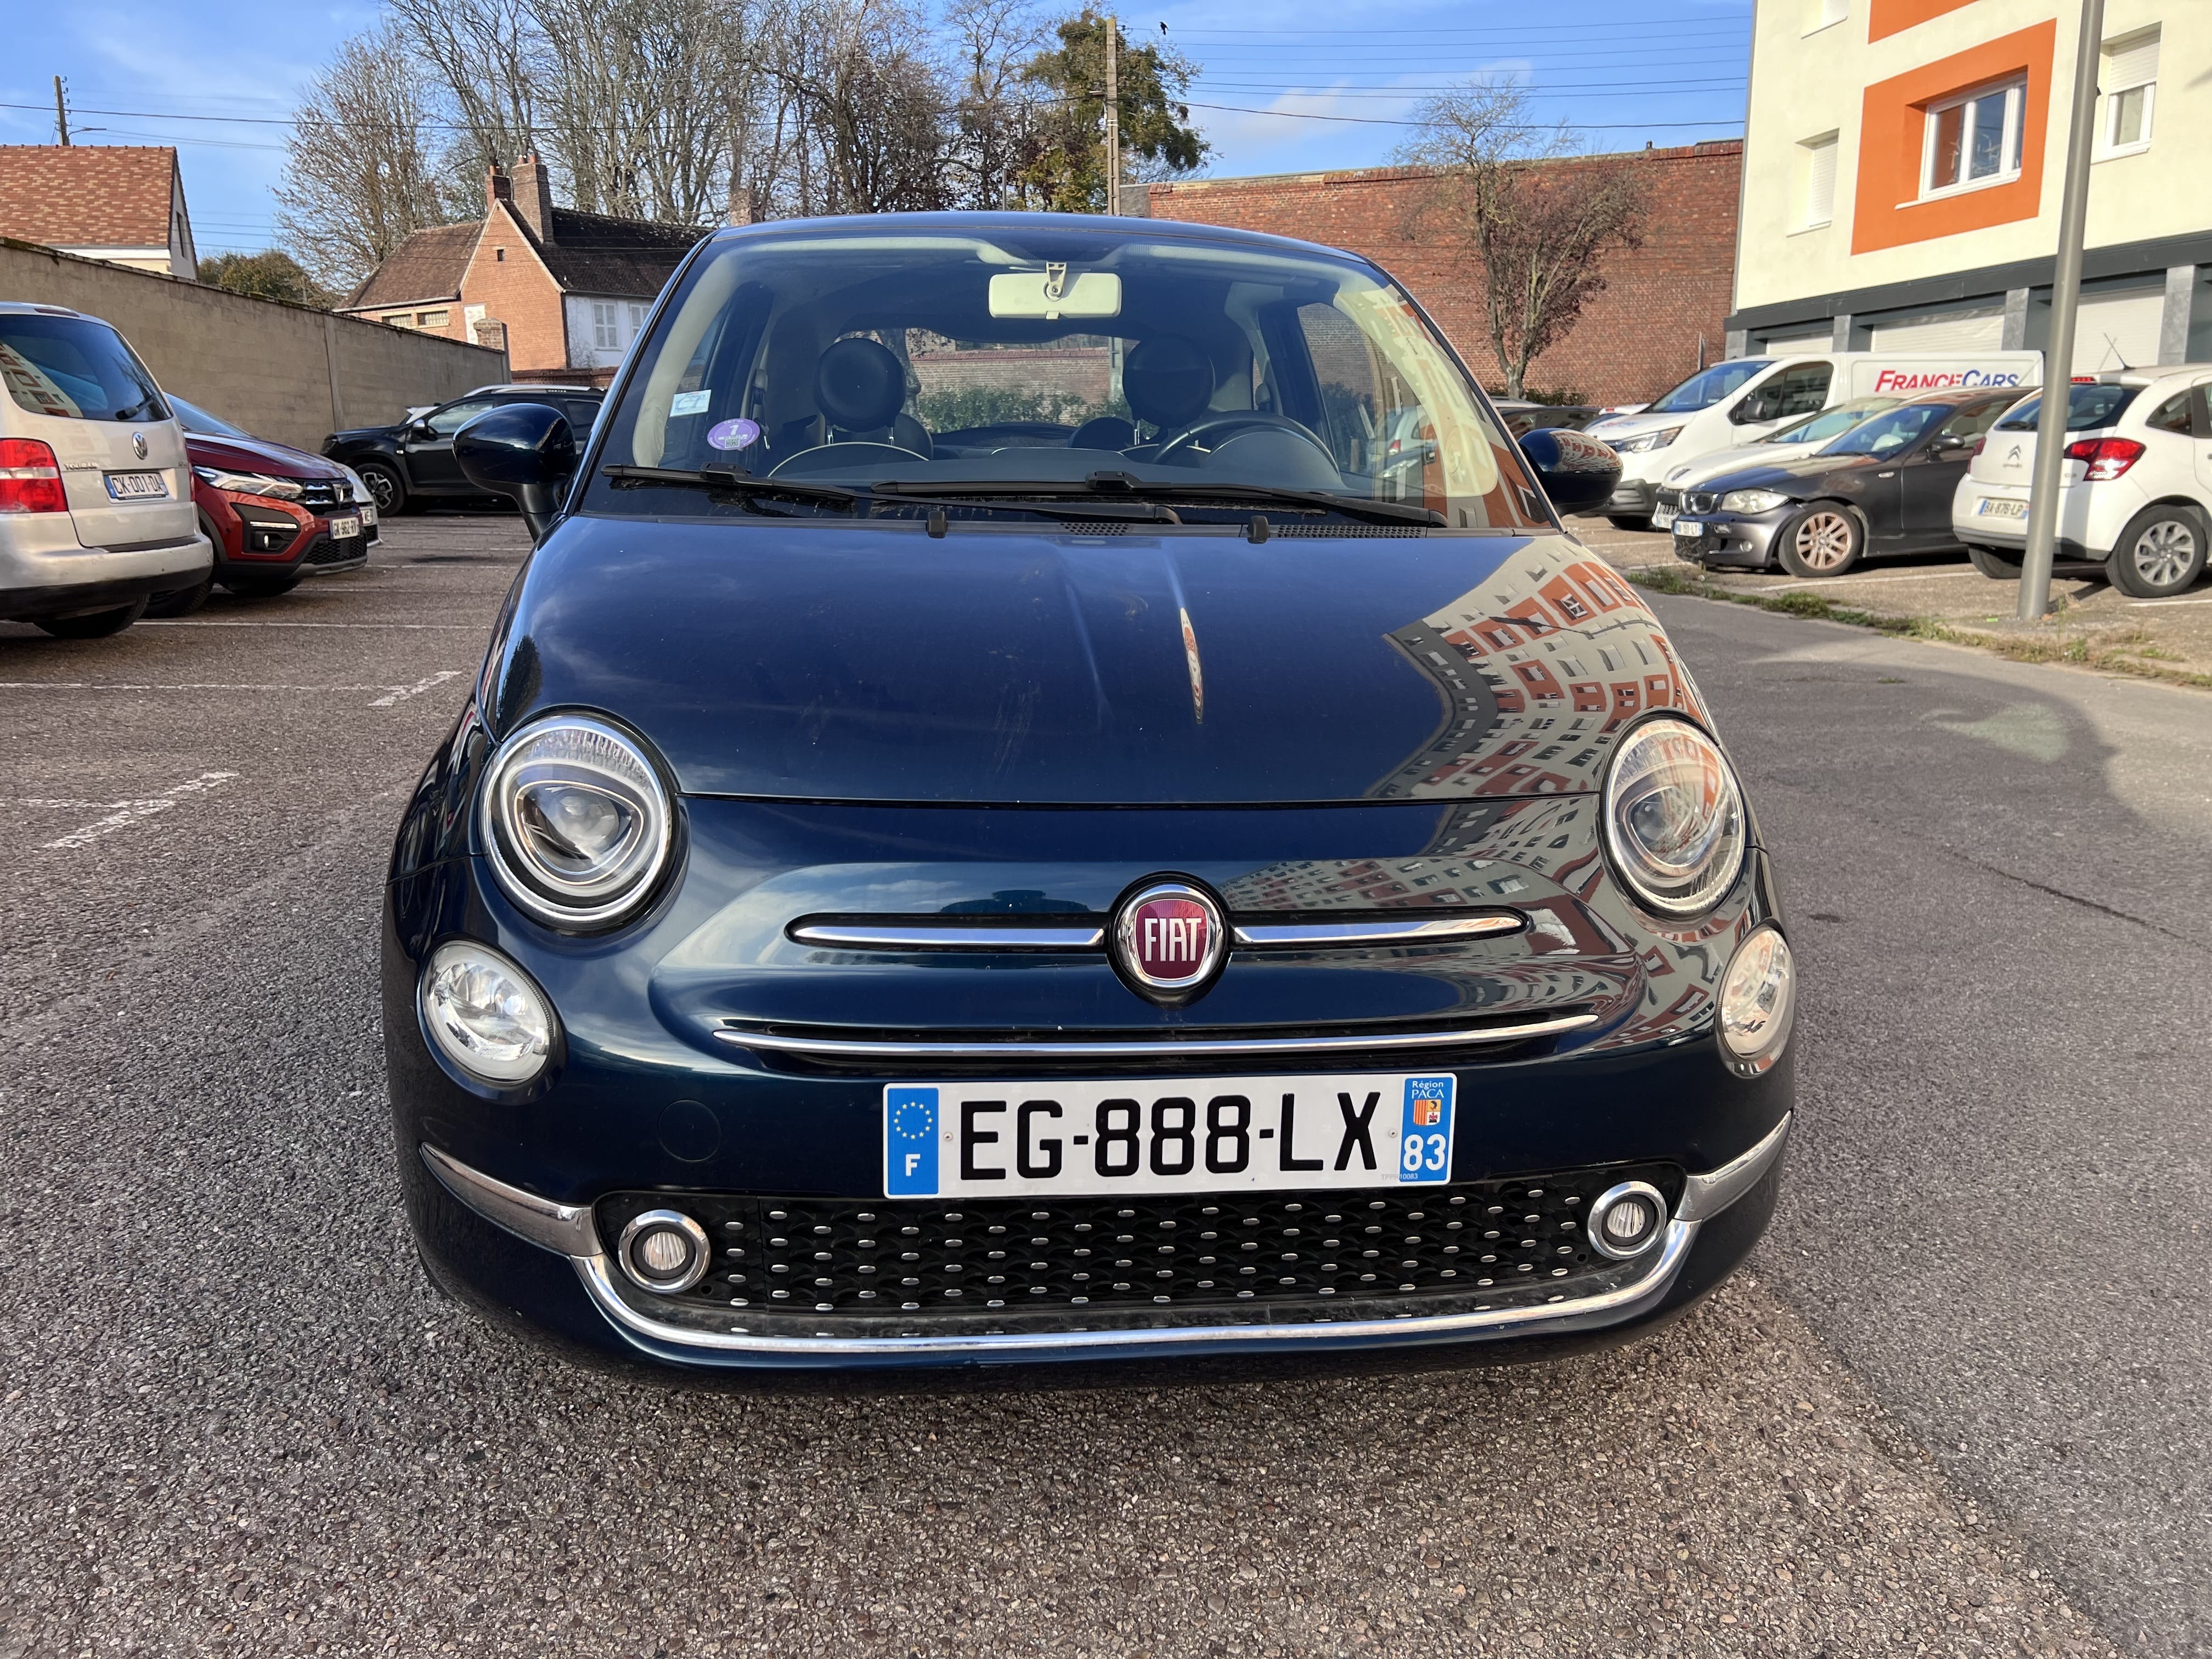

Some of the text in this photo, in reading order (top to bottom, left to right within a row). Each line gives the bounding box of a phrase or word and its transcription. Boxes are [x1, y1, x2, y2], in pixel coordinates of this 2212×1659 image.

[1144, 918, 1201, 962] FIAT
[1412, 1080, 1444, 1090] Région
[1412, 1088, 1444, 1099] PACA
[960, 1092, 1381, 1181] EG-888-LX
[905, 1153, 921, 1177] F
[1403, 1133, 1447, 1172] 83
